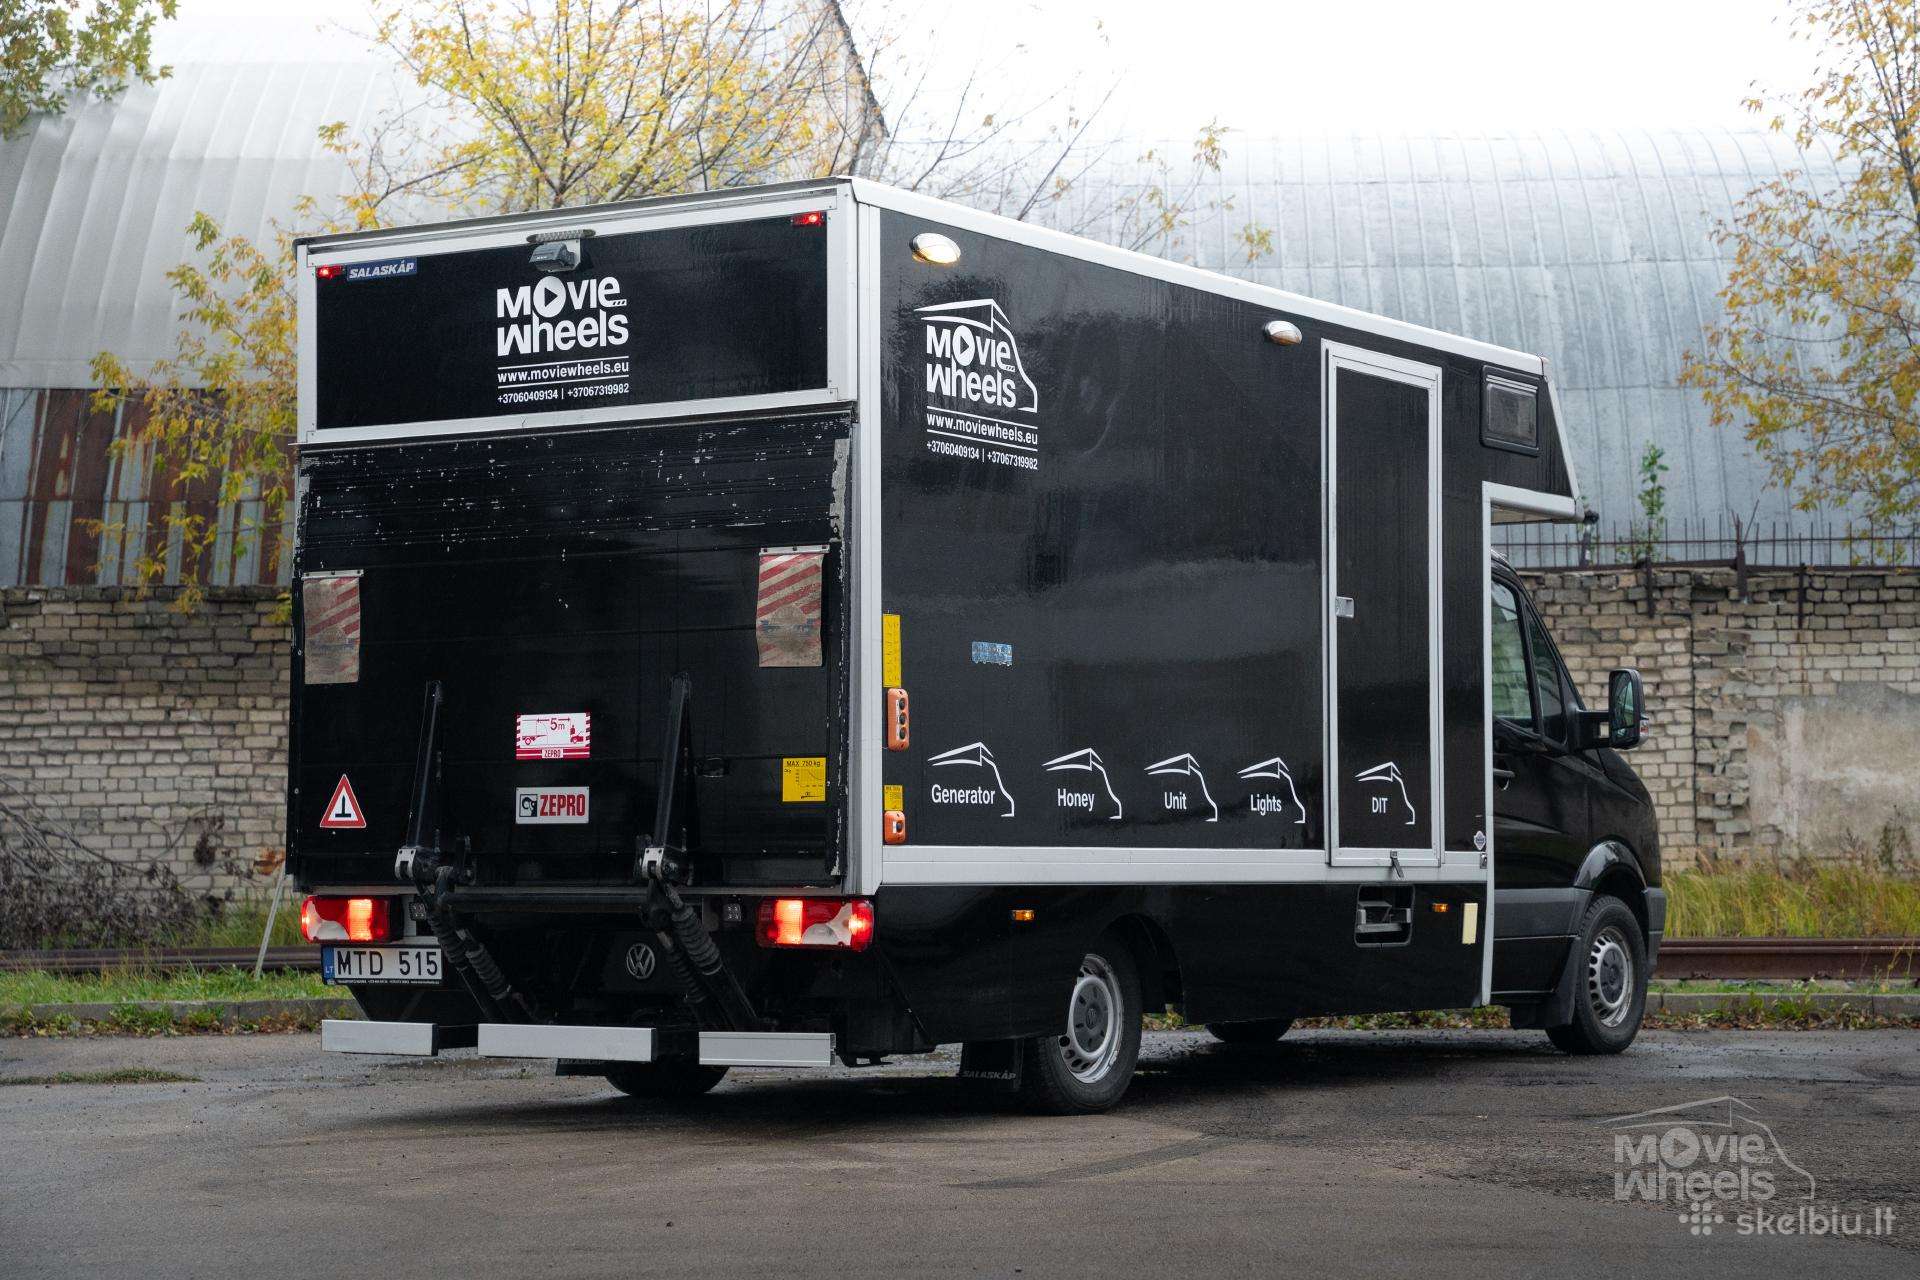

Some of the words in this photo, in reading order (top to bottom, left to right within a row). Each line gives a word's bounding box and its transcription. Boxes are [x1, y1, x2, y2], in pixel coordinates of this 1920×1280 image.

[497, 309, 629, 357] Wheels
[497, 359, 630, 383] www.moviewheels.eu
[926, 354, 1017, 408] Wheels
[497, 388, 559, 404] +37060409134
[567, 383, 630, 398] +37067319982
[926, 413, 1039, 446] www.moviewheels.eu
[926, 440, 980, 460] +37060409134
[987, 451, 1039, 470] +37067319982
[544, 749, 561, 758] ZEPRO
[786, 760, 800, 768] MAX
[540, 794, 586, 817] ZEPRO
[931, 784, 996, 805] Generator
[1057, 788, 1095, 812] Honey
[1164, 791, 1187, 811] Unit
[1250, 793, 1282, 814] Lights
[1372, 796, 1388, 814] DIT
[325, 966, 334, 974] LT
[337, 950, 384, 976] MTD
[399, 951, 438, 976] 515
